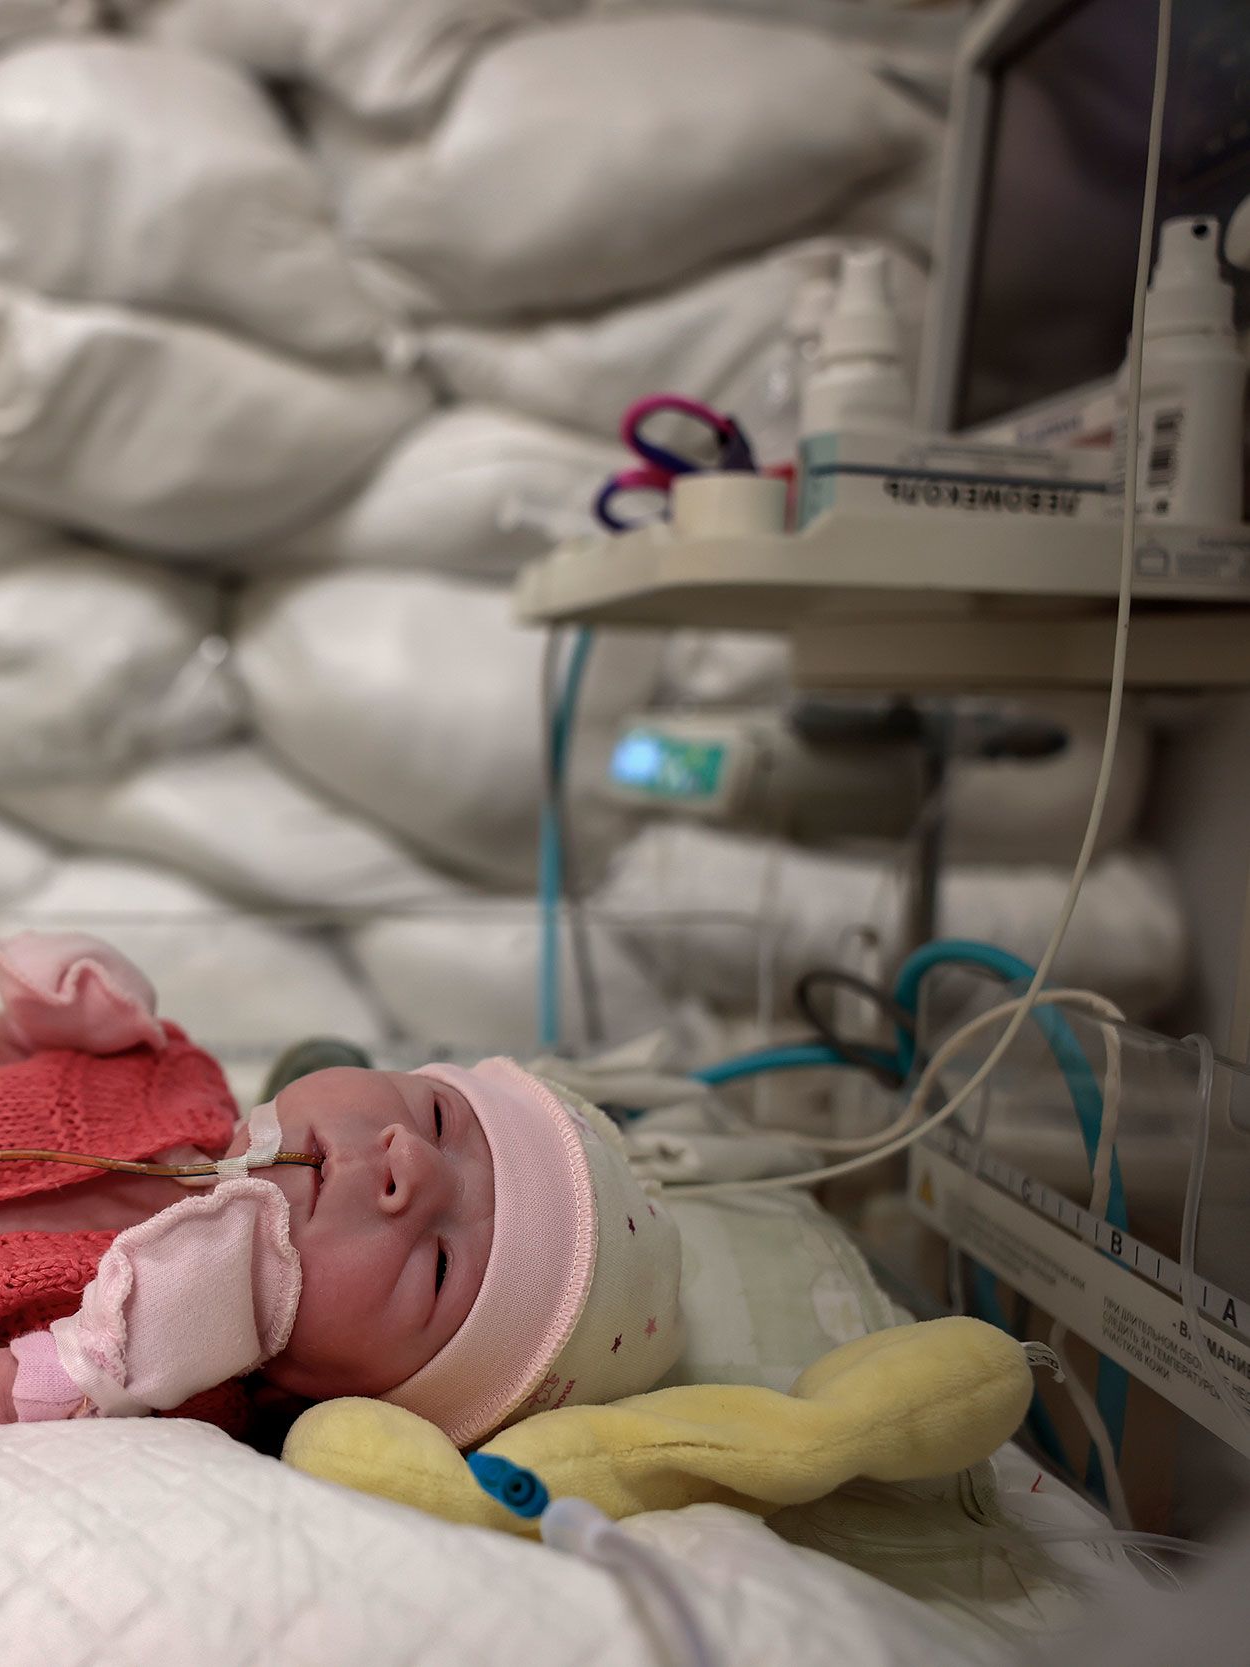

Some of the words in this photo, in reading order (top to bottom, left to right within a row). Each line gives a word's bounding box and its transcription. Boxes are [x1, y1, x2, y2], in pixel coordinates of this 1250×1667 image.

[1111, 1230, 1122, 1256] B
[1222, 1298, 1238, 1328] A
[1152, 1343, 1221, 1400] ТЕМПЕРАТУРО
